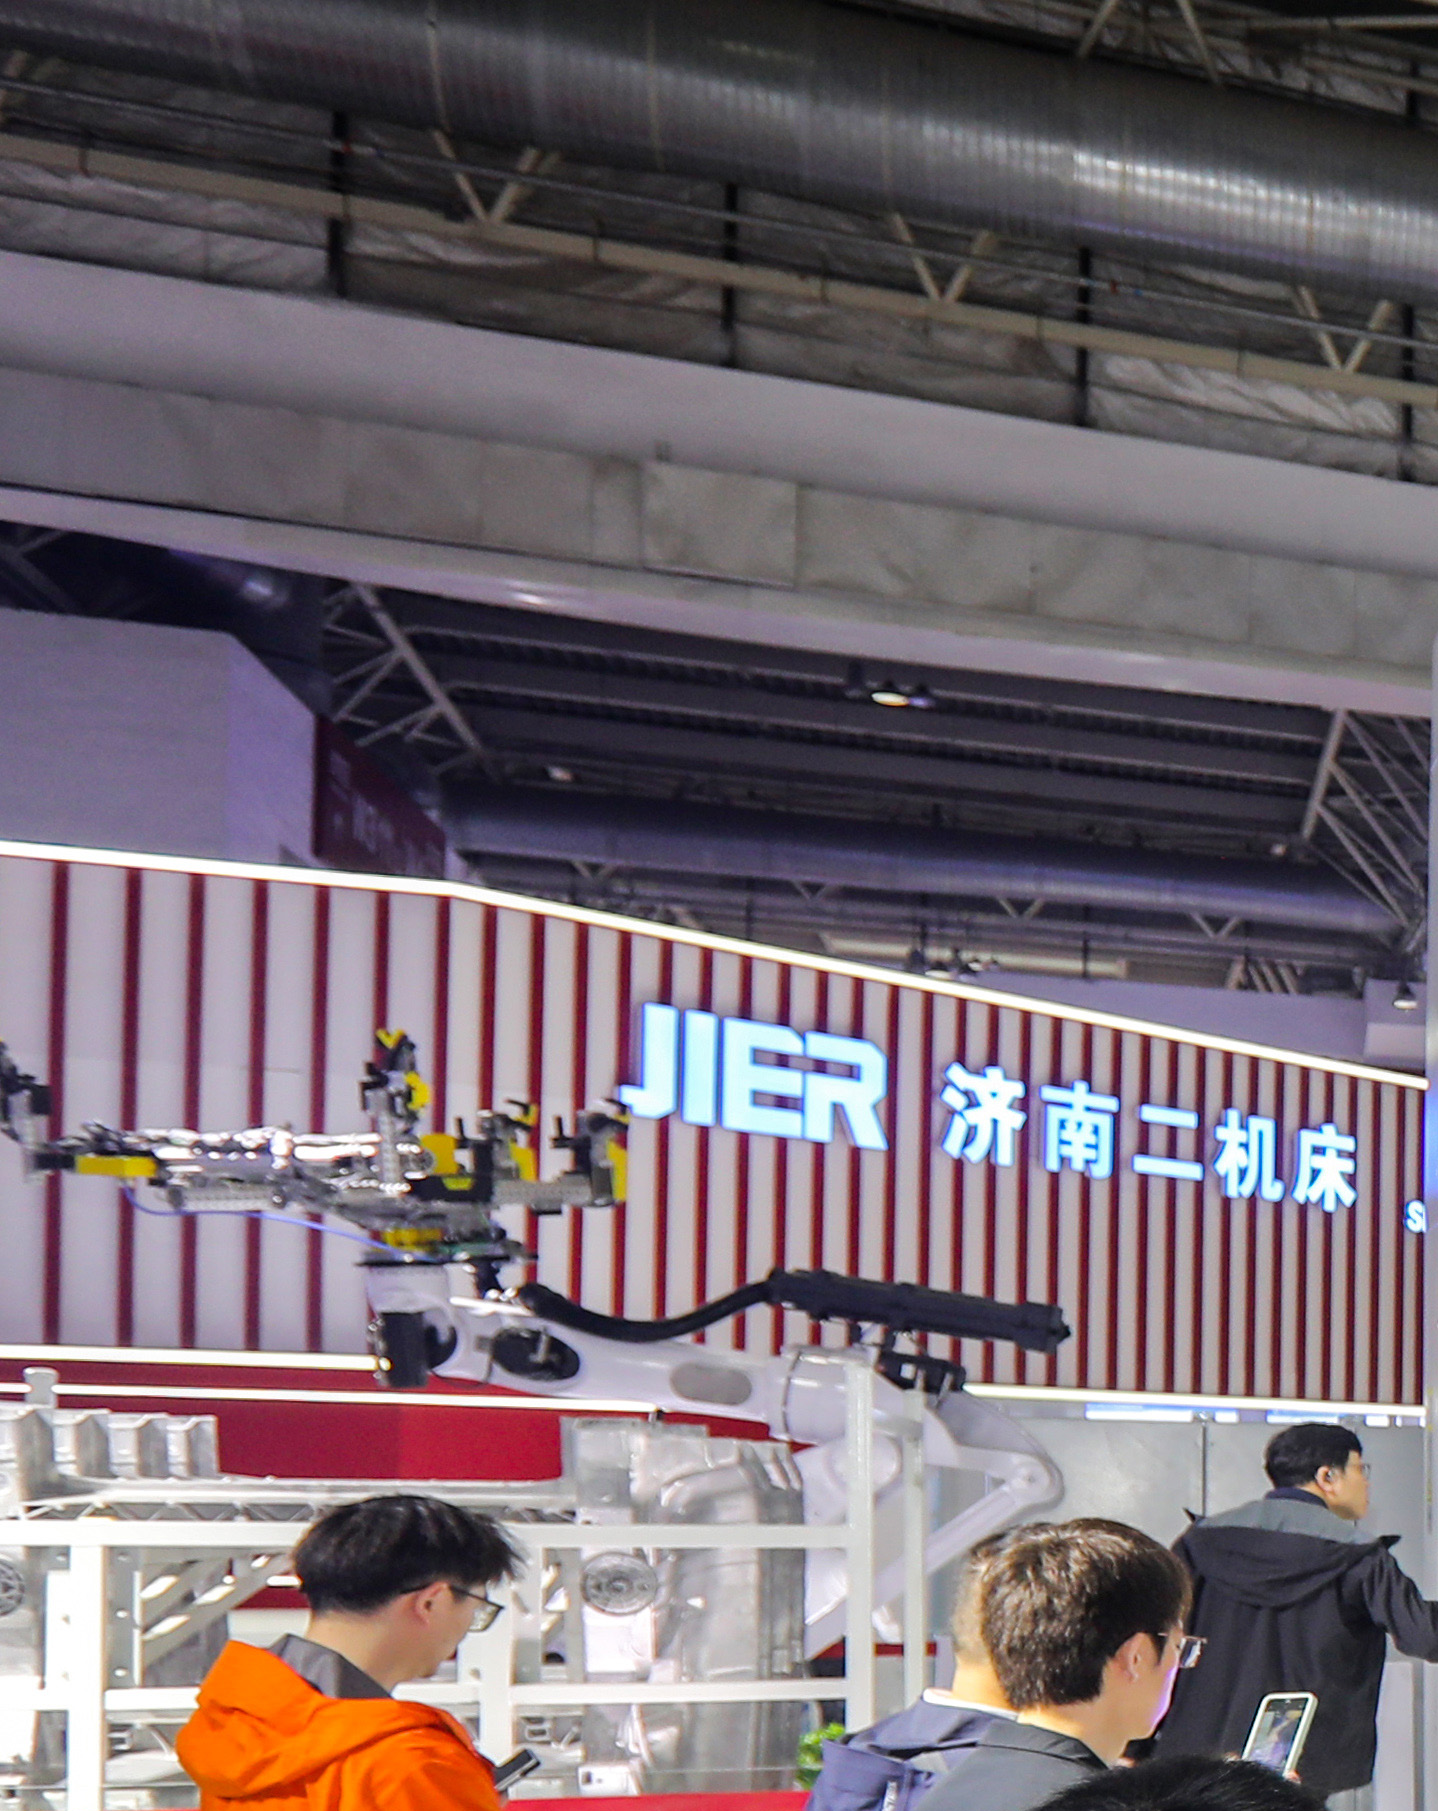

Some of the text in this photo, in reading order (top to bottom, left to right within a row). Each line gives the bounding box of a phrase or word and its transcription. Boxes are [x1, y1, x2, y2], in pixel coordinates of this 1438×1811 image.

[620, 1003, 888, 1150] JIER
[940, 1062, 1358, 1213] 济南二机床
